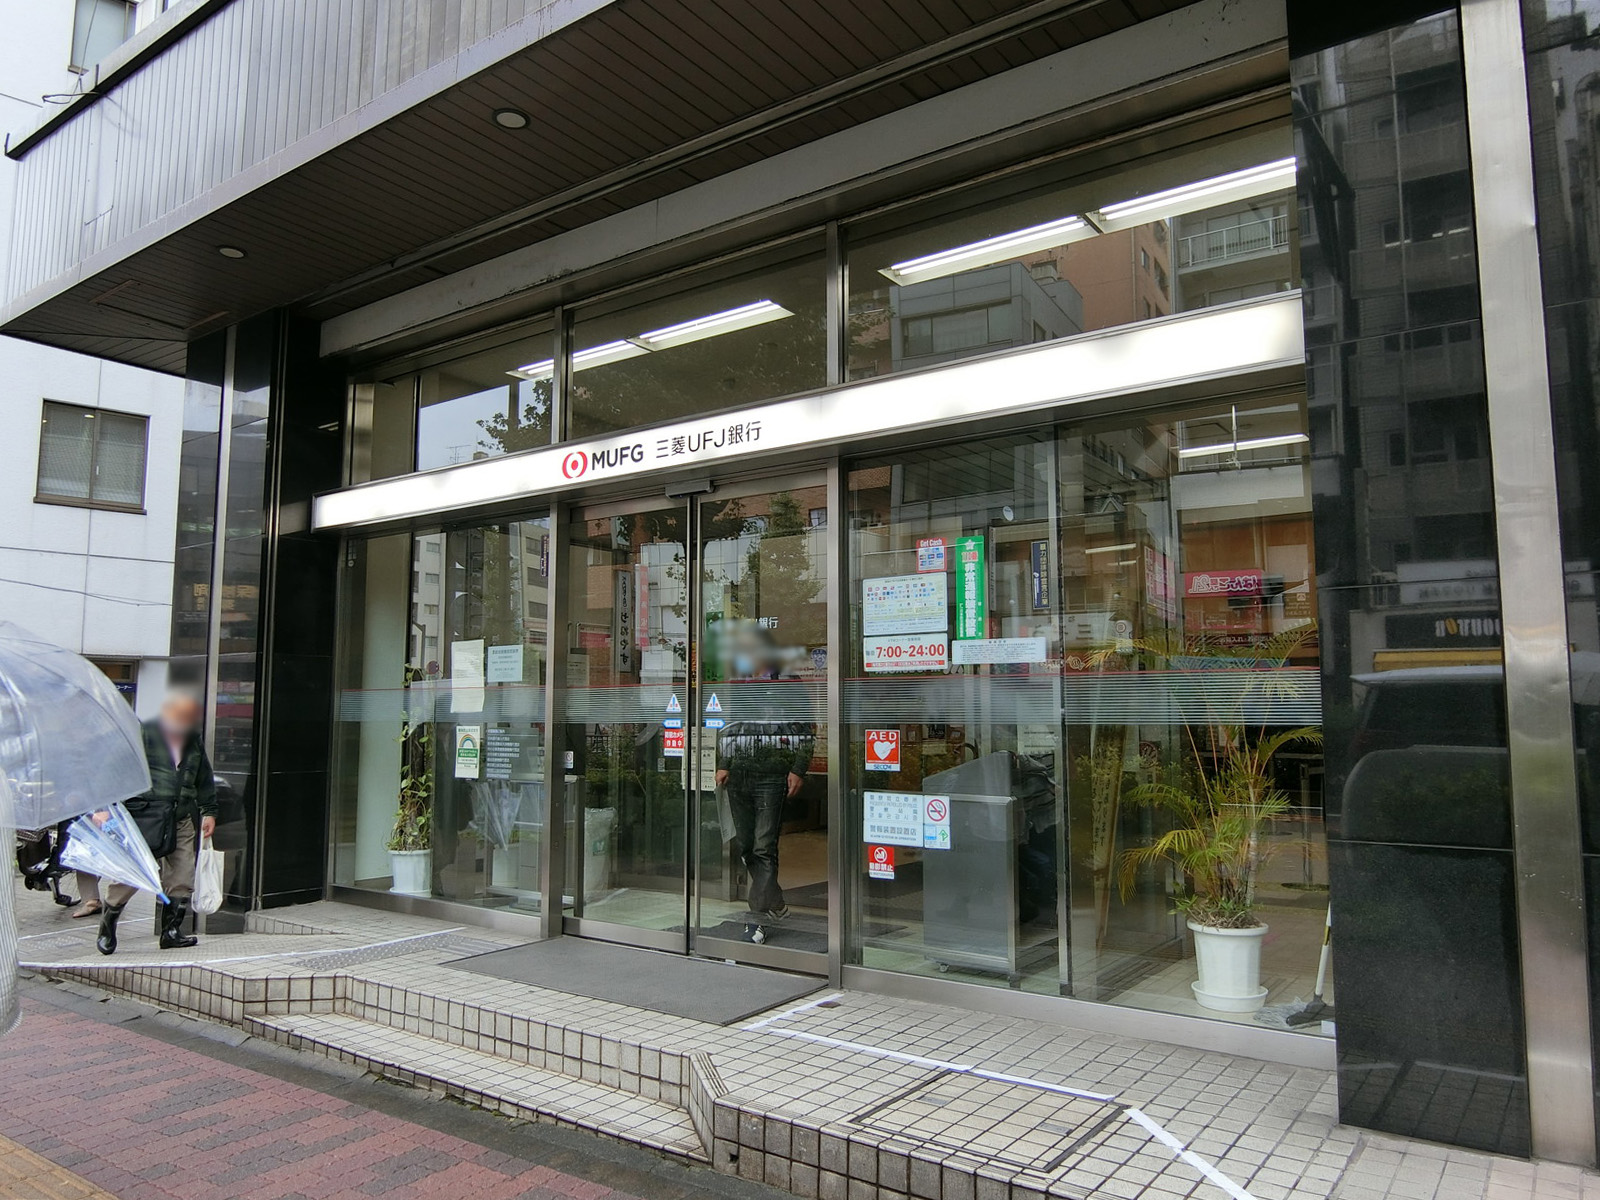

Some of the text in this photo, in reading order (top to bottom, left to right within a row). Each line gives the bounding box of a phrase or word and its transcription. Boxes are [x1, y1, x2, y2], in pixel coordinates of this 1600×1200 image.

[656, 421, 762, 459] 三菱UFJ銀行
[592, 444, 644, 470] MUFG
[876, 644, 945, 659] 7:00~24:00
[868, 731, 897, 740] AED
